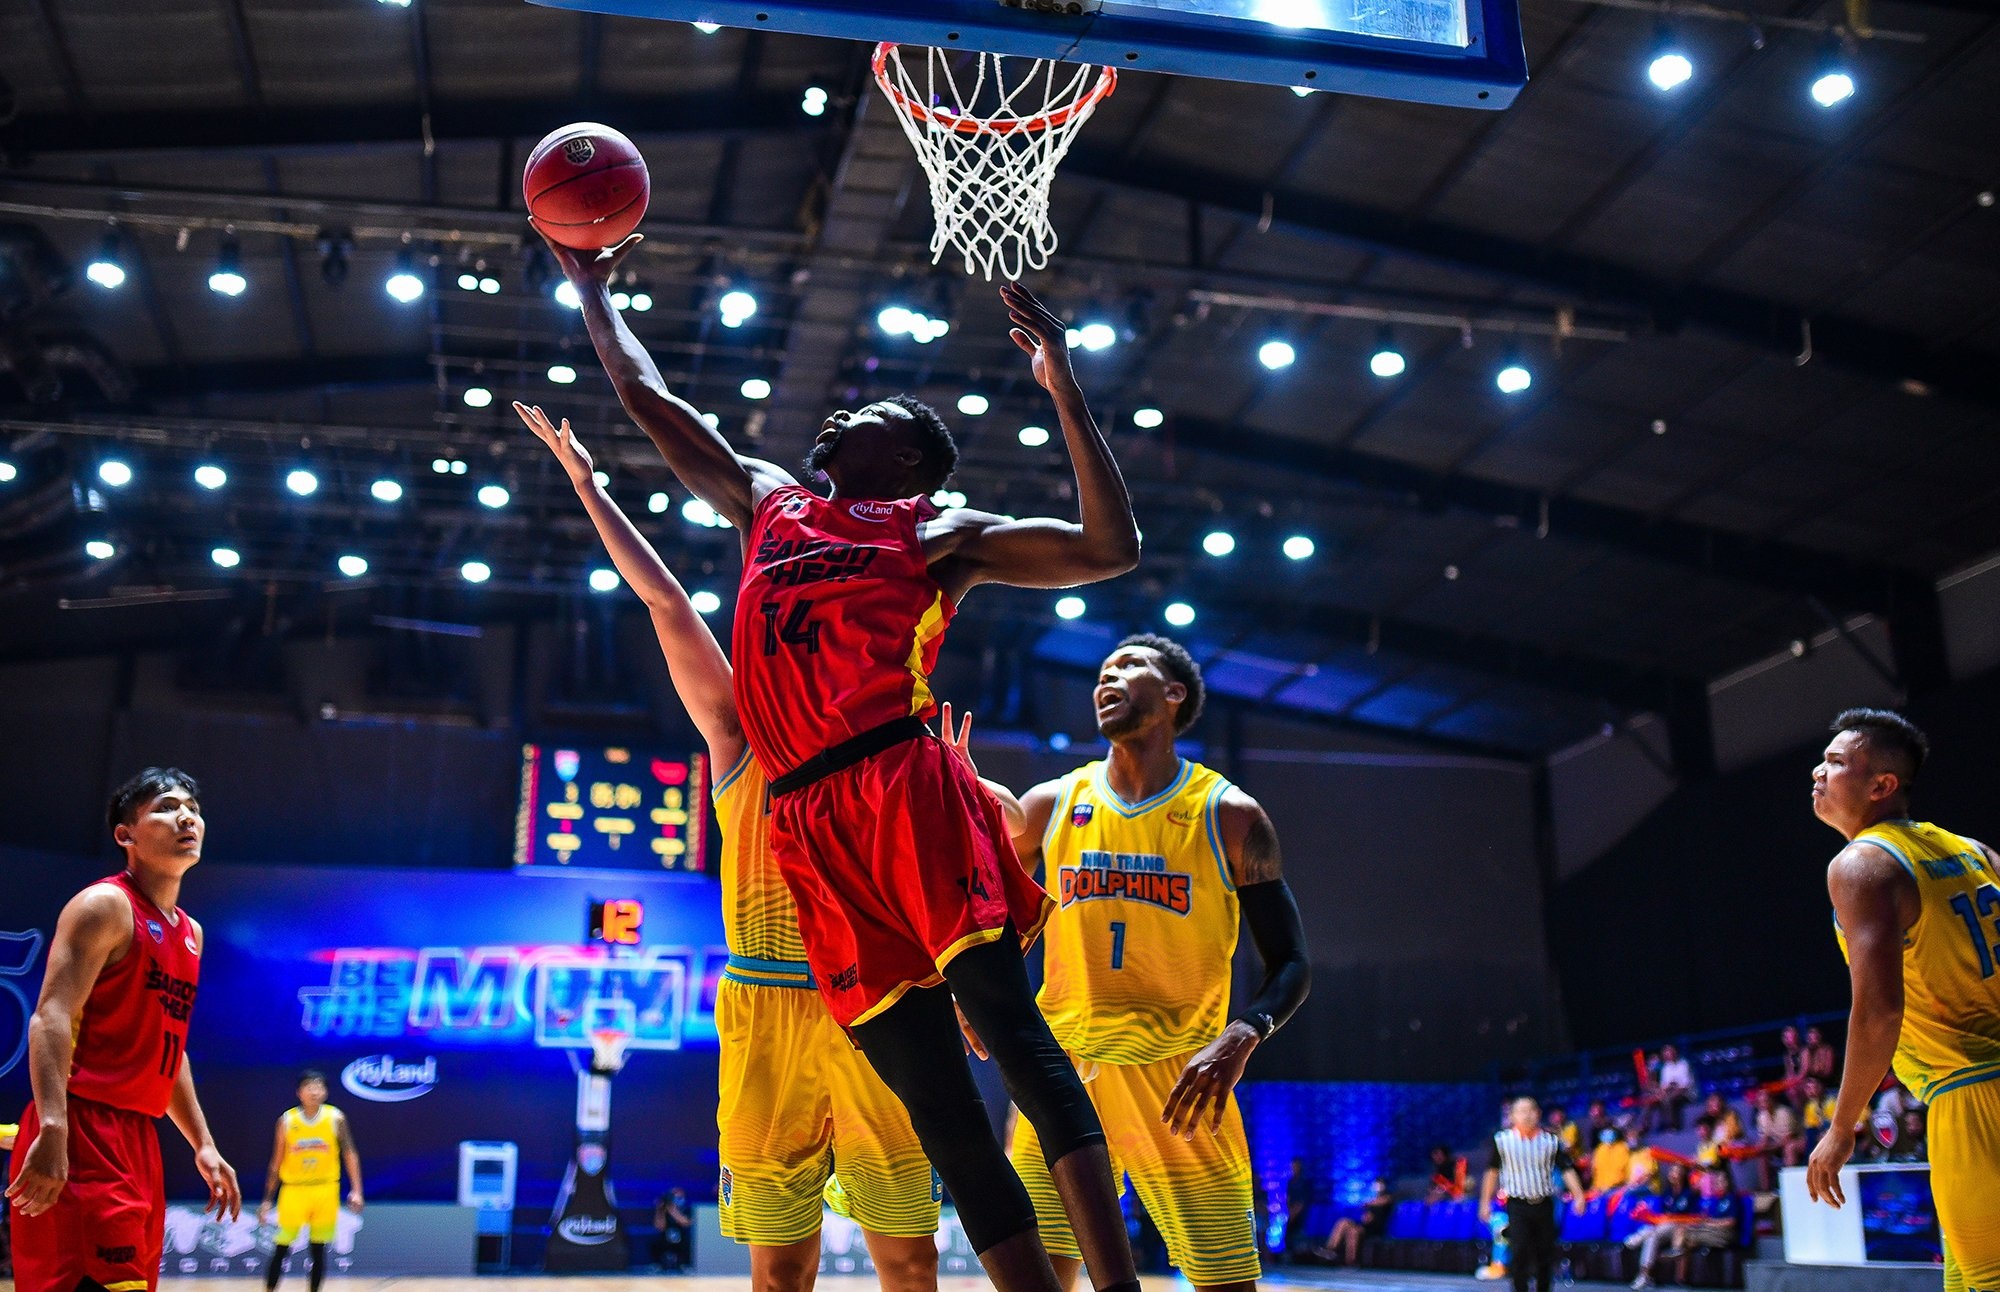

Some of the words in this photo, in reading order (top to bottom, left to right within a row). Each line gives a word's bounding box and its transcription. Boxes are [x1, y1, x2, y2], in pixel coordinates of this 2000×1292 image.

[564, 138, 590, 154] VBA
[754, 536, 879, 567] SAIGON
[763, 563, 867, 587] HEAT
[760, 600, 821, 656] 14
[1081, 851, 1112, 868] NHA
[1115, 854, 1166, 873] TRANG
[957, 867, 989, 902] 14
[1060, 868, 1192, 914] DOLPHINS
[603, 900, 643, 945] 12
[1110, 921, 1127, 971] 1
[159, 1030, 180, 1079] 11
